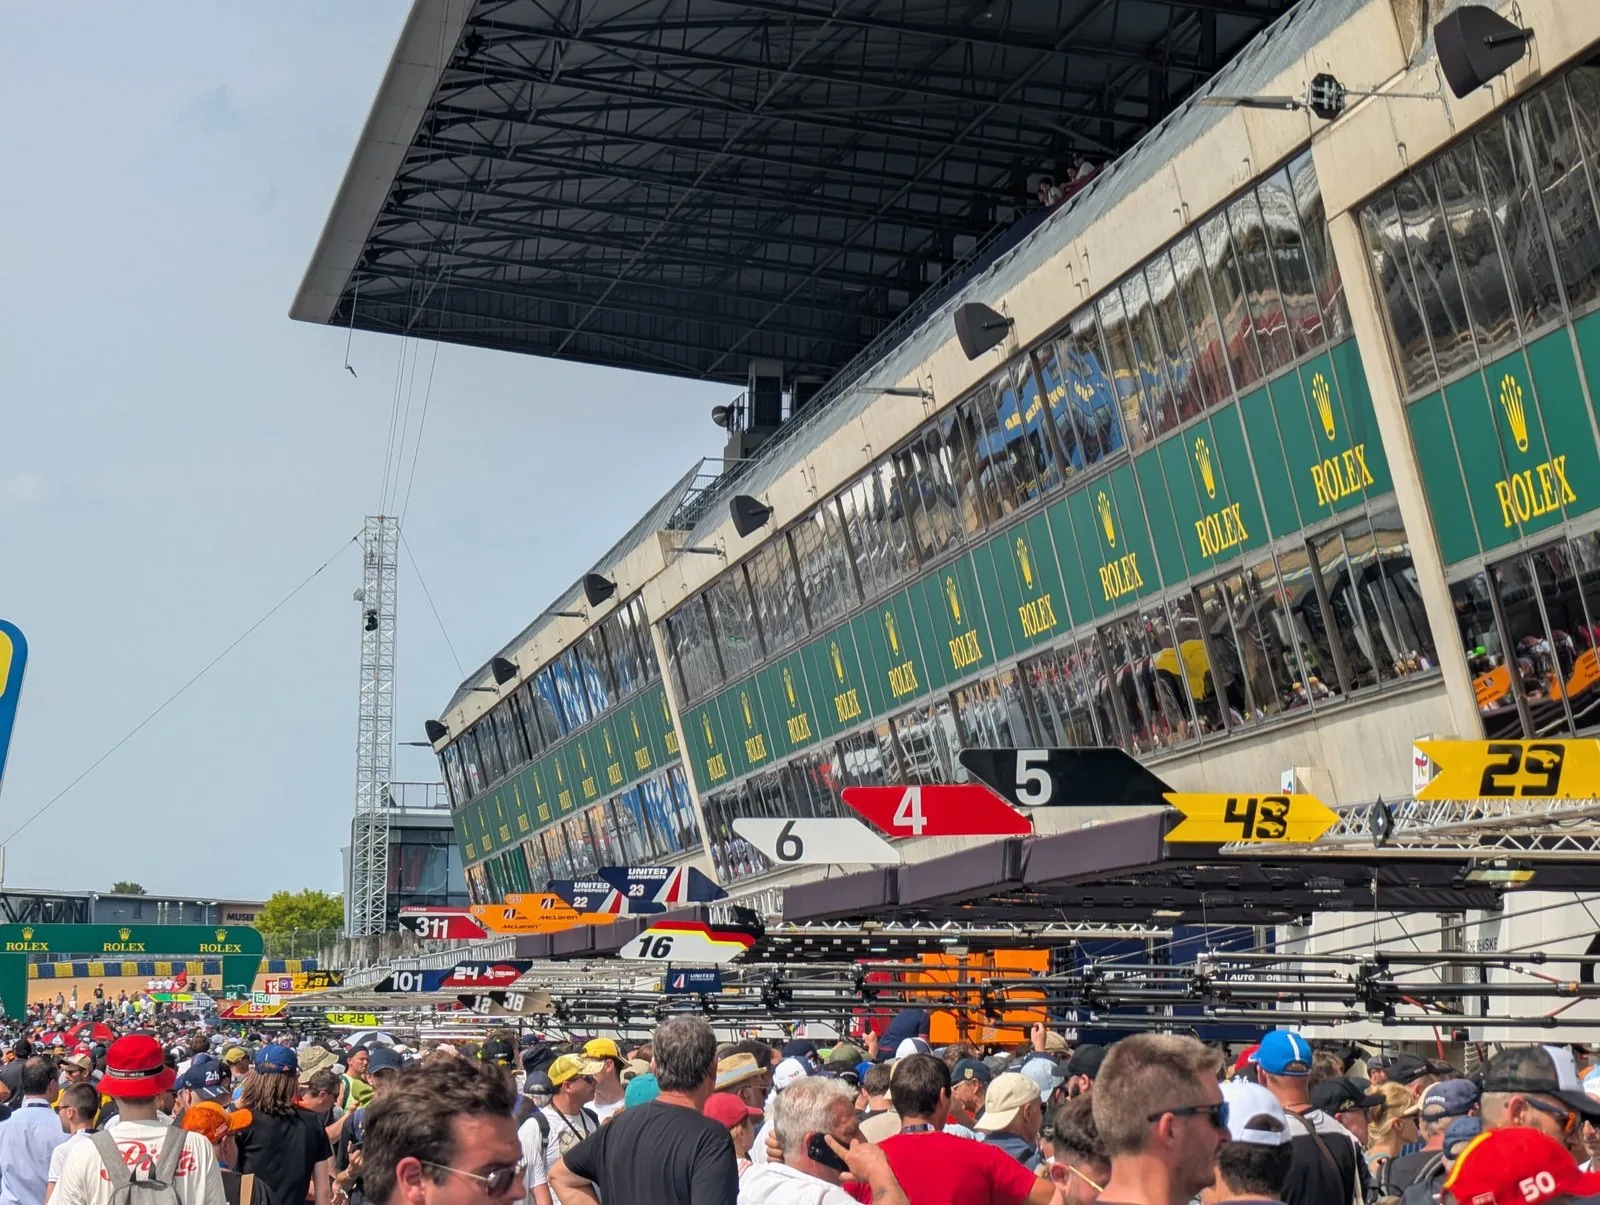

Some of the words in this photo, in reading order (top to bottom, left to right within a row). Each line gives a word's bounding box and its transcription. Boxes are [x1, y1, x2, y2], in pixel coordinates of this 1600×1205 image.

[1311, 444, 1374, 507] ROLEX
[1495, 455, 1576, 528] ROLEX
[1195, 502, 1249, 558] ROLEX
[1099, 552, 1144, 601] ROLEX
[1018, 594, 1057, 638] ROLEX
[948, 629, 983, 669] ROLEX
[888, 661, 918, 698] ROLEX
[834, 688, 862, 722] ROLEX
[787, 712, 812, 744] ROLEX
[745, 733, 767, 764] ROLEX
[707, 753, 727, 781] ROLEX
[1014, 749, 1053, 806] 5
[1480, 743, 1566, 797] 29
[893, 786, 928, 835] 4
[1223, 797, 1291, 839] 48
[775, 819, 804, 862] 6
[573, 897, 588, 908] 22
[628, 884, 645, 897] 23
[415, 917, 449, 938] 311
[6, 942, 49, 952] ROLEX
[103, 942, 146, 952] ROLEX
[200, 943, 242, 953] ROLEX
[638, 935, 674, 958] 16
[267, 981, 280, 993] 13
[391, 971, 423, 991] 101
[453, 966, 480, 980] 24
[226, 992, 237, 1001] 54
[249, 1004, 264, 1013] 83
[254, 991, 270, 1003] 150
[472, 995, 492, 1014] 12
[503, 992, 524, 1012] 38
[350, 1013, 365, 1023] 28
[1519, 1171, 1556, 1202] 50
